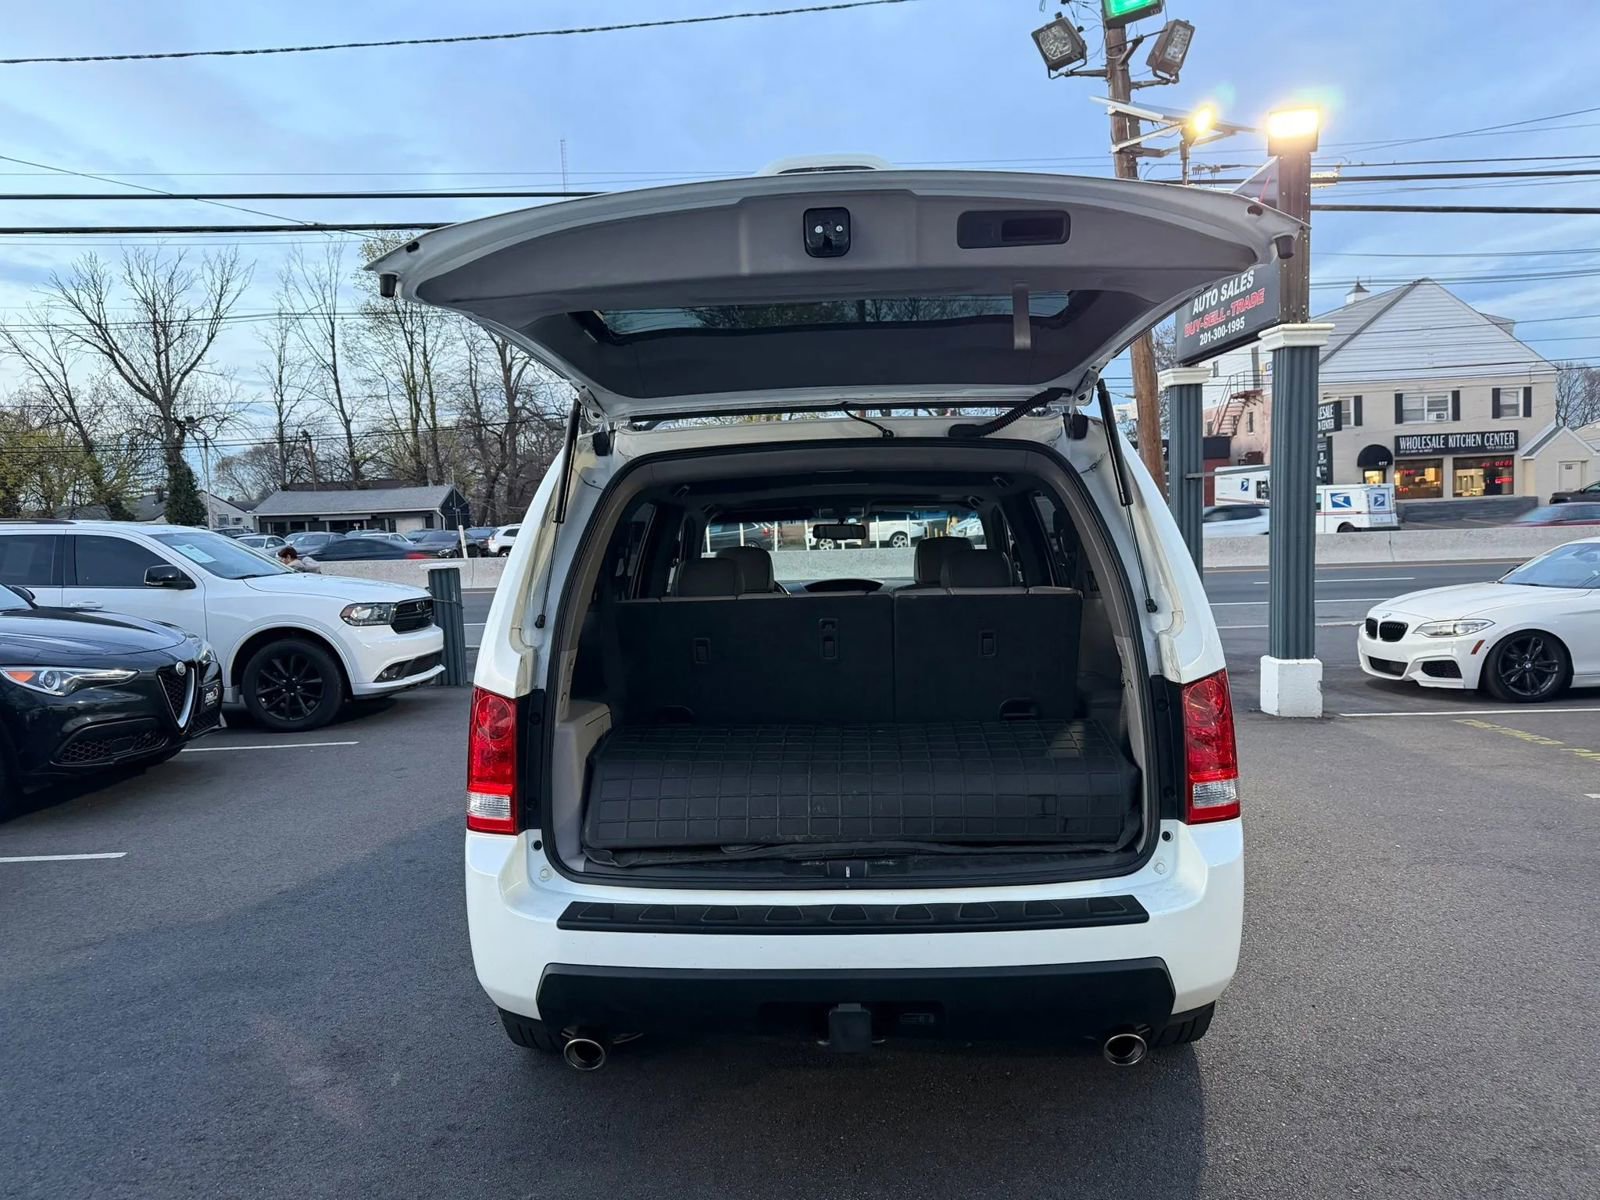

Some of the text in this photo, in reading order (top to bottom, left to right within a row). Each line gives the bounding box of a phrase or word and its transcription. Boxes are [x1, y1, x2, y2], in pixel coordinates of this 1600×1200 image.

[1192, 269, 1254, 315] AUTO SALES
[1200, 316, 1245, 346] 201-300-1995
[1399, 431, 1515, 450] WHOLESALE KITCHEN CENTER
